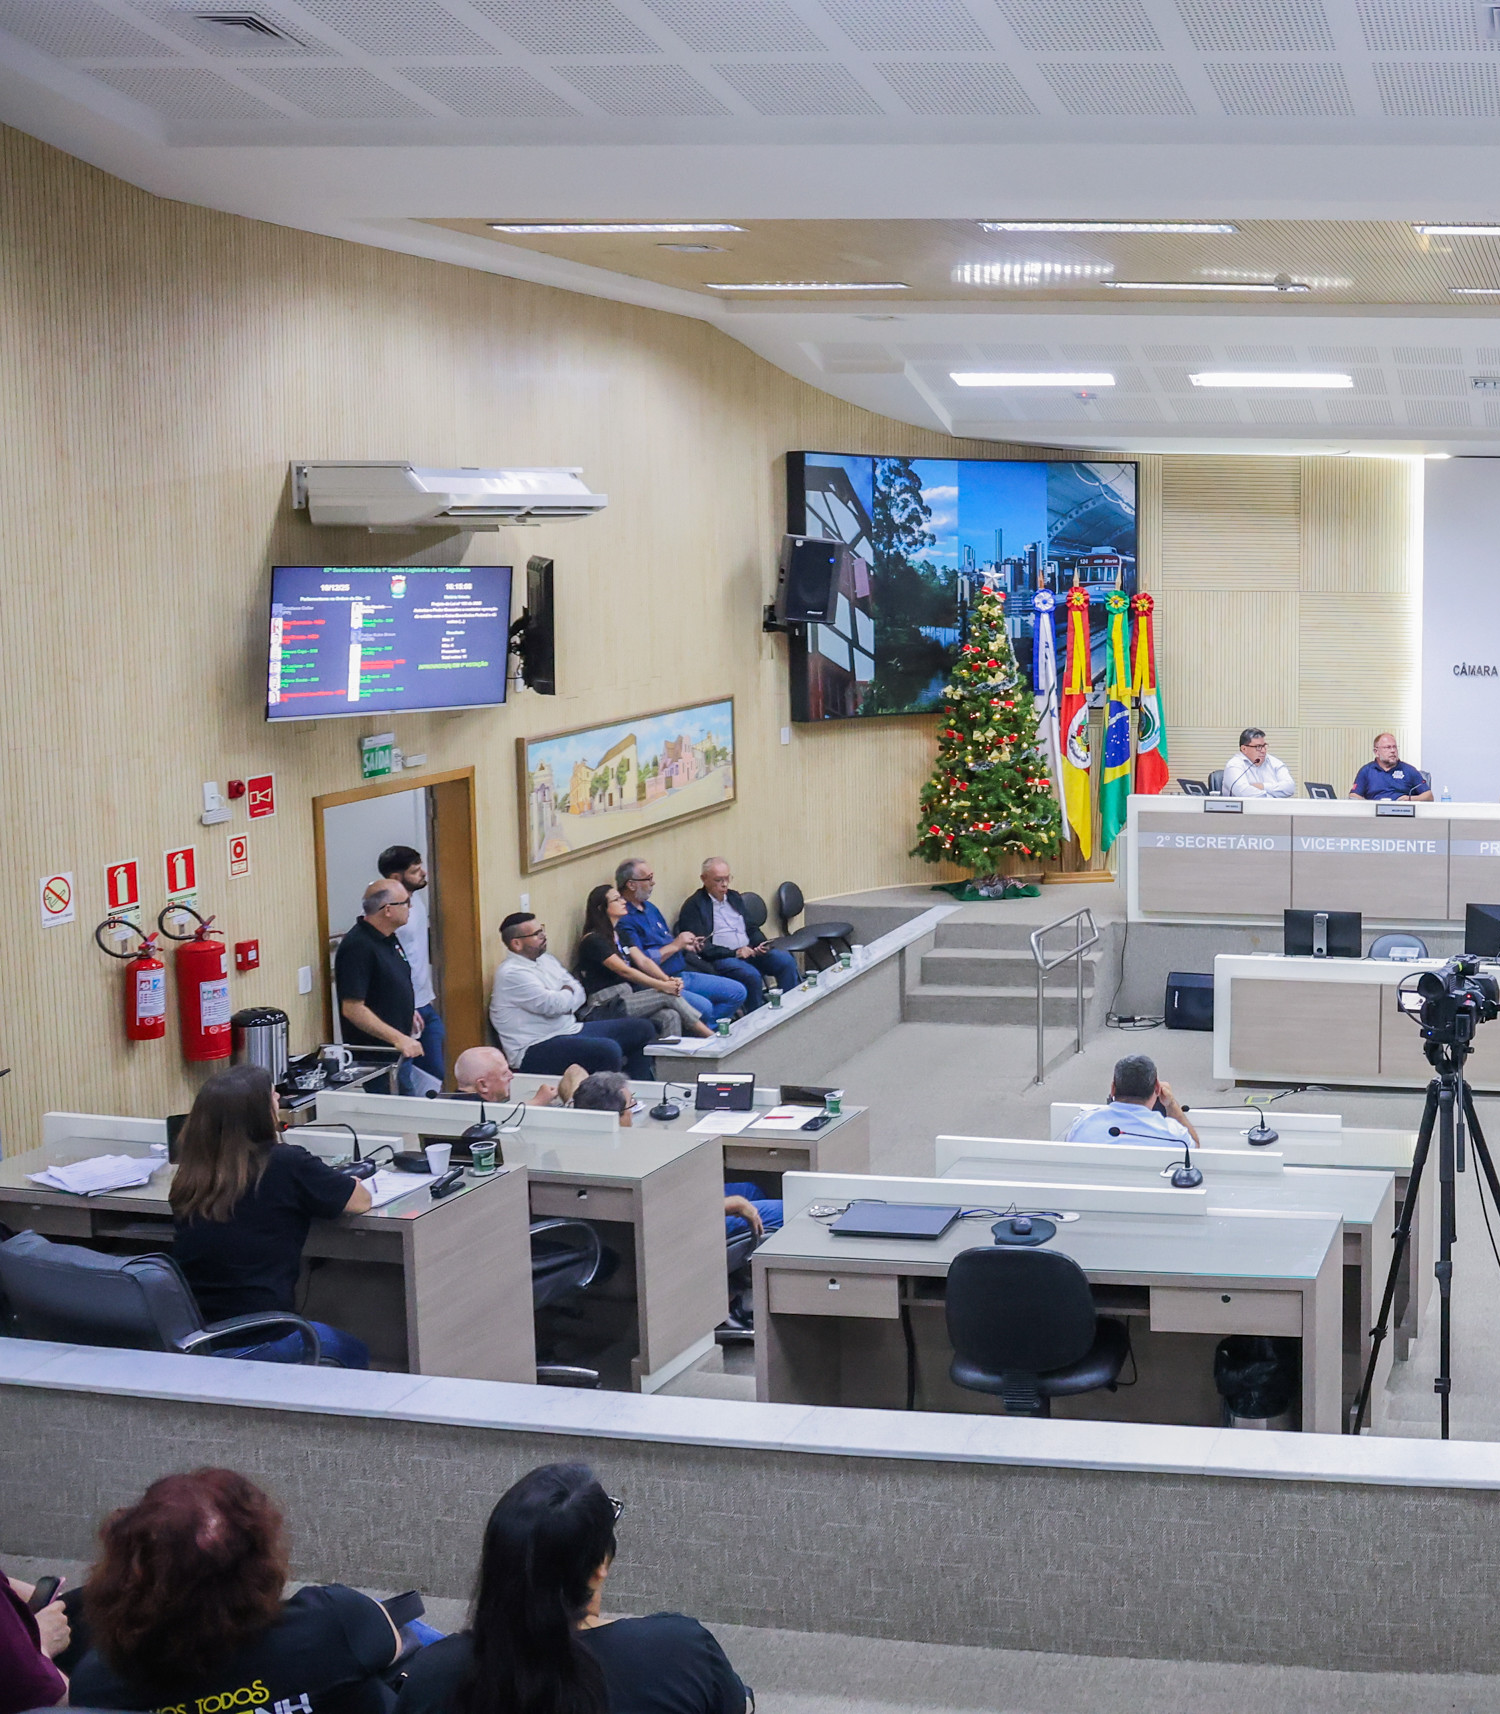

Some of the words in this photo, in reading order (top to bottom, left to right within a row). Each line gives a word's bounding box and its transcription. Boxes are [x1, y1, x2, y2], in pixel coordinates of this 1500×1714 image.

[1453, 662, 1497, 676] CÂMARA
[364, 746, 390, 772] SAÍDA
[1175, 835, 1274, 851] SECRETÁRIO
[1300, 837, 1436, 853] VICE-PRESIDENTE
[195, 1680, 270, 1714] TODOS
